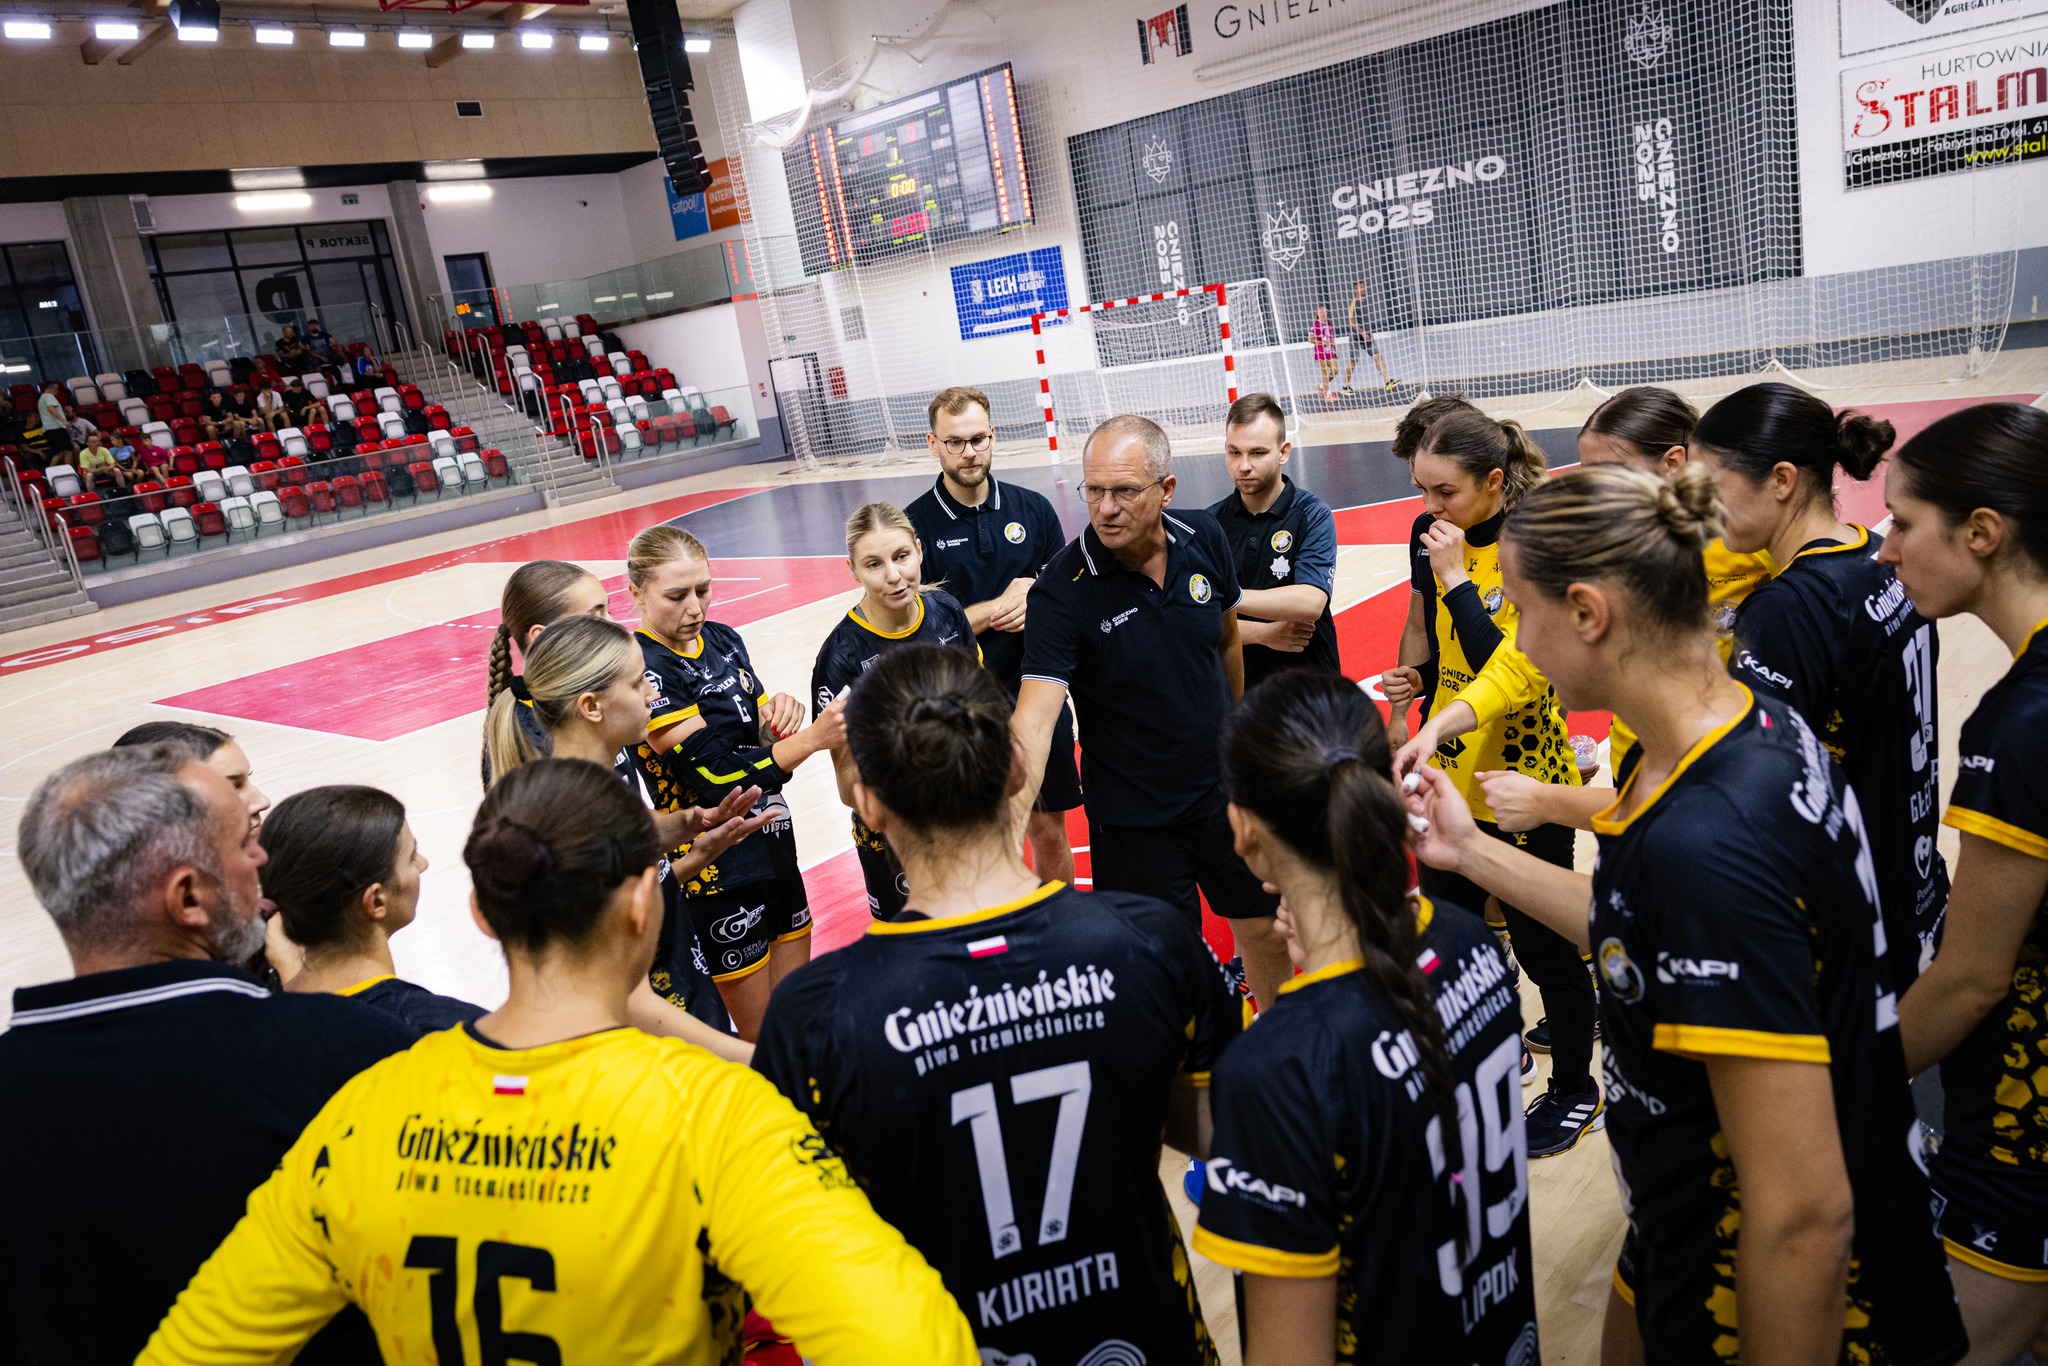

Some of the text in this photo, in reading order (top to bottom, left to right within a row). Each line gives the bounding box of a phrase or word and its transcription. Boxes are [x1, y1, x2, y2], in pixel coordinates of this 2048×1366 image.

[1635, 123, 1656, 201] 2025
[1965, 134, 2048, 163] www.stal
[1332, 155, 1506, 210] GNIEZNO
[1655, 118, 1679, 253] GNIEZNO
[1336, 200, 1434, 239] 2025
[1154, 225, 1171, 284] 2025
[988, 275, 1018, 298] LECH
[1441, 666, 1477, 684] GNIEZN
[1743, 655, 1793, 690] KAPI
[1433, 751, 1459, 769] RBIS
[1669, 957, 1739, 981] KAPI
[884, 964, 1116, 1053] Gnieźnieńskie
[914, 1009, 1106, 1077] piwa rzemieślnicze
[397, 1113, 617, 1171] Gnieźnieńskie
[951, 1060, 1092, 1260] 17
[1226, 1167, 1306, 1208] KAPI
[403, 1234, 562, 1366] 16
[977, 1251, 1120, 1329] KURIATA
[1462, 1247, 1519, 1334] LIPOK
